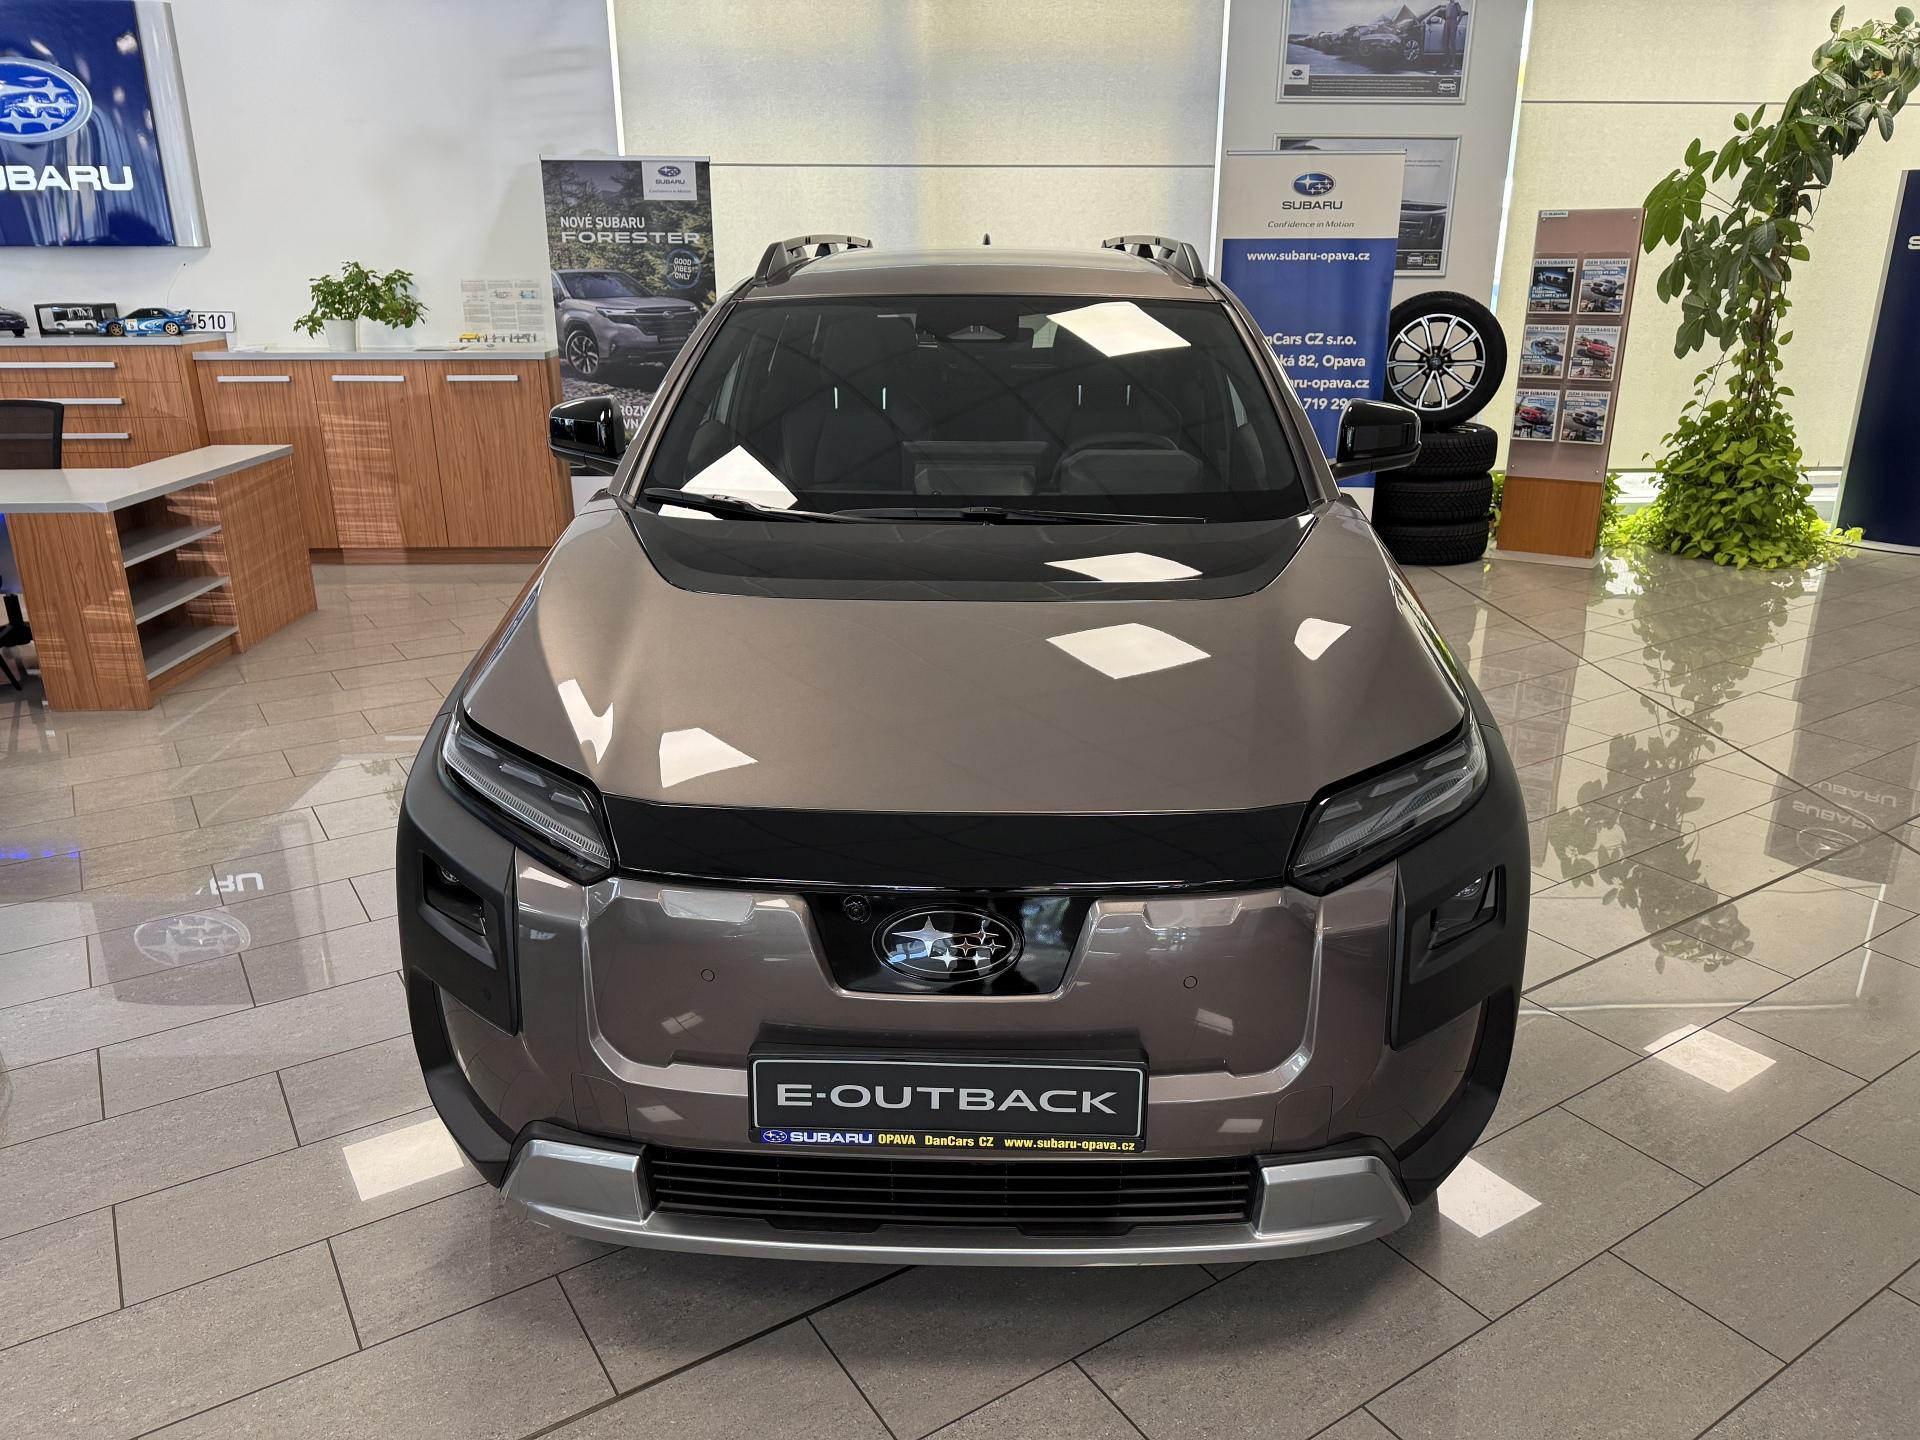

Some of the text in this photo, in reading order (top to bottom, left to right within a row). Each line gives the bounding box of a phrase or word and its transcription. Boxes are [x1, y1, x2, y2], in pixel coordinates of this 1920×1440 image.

[0, 165, 134, 191] BARU
[1282, 201, 1343, 210] SUBARU
[560, 213, 645, 229] NOVÉ SUBARU
[1267, 220, 1355, 229] Confidence in Motion
[561, 231, 700, 244] FORESTER
[673, 257, 692, 266] GOOD
[1247, 250, 1370, 263] www.subaru-opava.cz
[673, 265, 692, 273] VIBES
[674, 272, 691, 280] ONLY
[192, 314, 227, 330] 510
[1265, 332, 1357, 345] nCars CZ s.r.o.
[1298, 355, 1319, 368] 82,
[1322, 355, 1366, 370] Opava
[1303, 397, 1348, 410] 719 29
[776, 1083, 1118, 1115] E-OUTBACK
[789, 1131, 1136, 1151] SUBARU OPAVA DanCars CZ www.subaru-opava.cz
